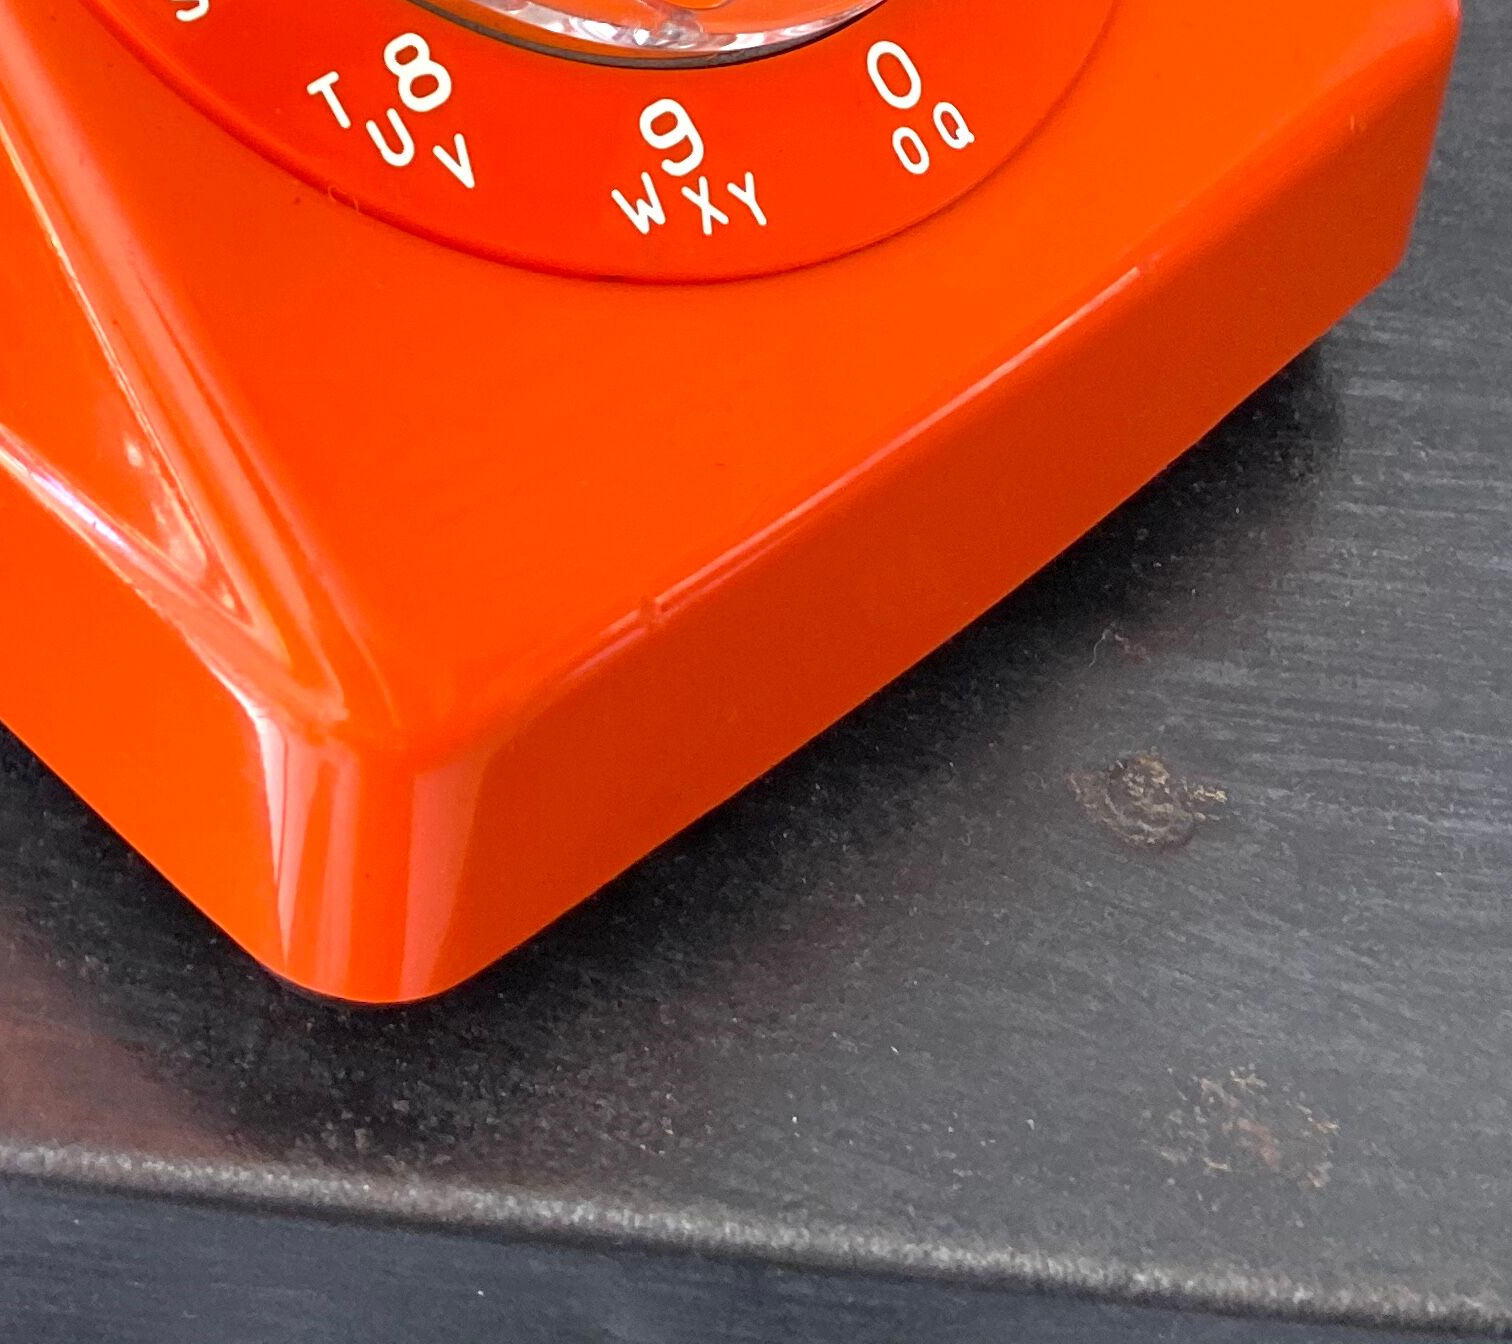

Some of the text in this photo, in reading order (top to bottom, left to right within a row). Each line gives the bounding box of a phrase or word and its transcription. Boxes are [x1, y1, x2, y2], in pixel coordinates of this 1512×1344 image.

[384, 33, 452, 112] 8
[307, 71, 475, 188] TUV
[639, 99, 704, 176] 9
[611, 172, 767, 235] WXY
